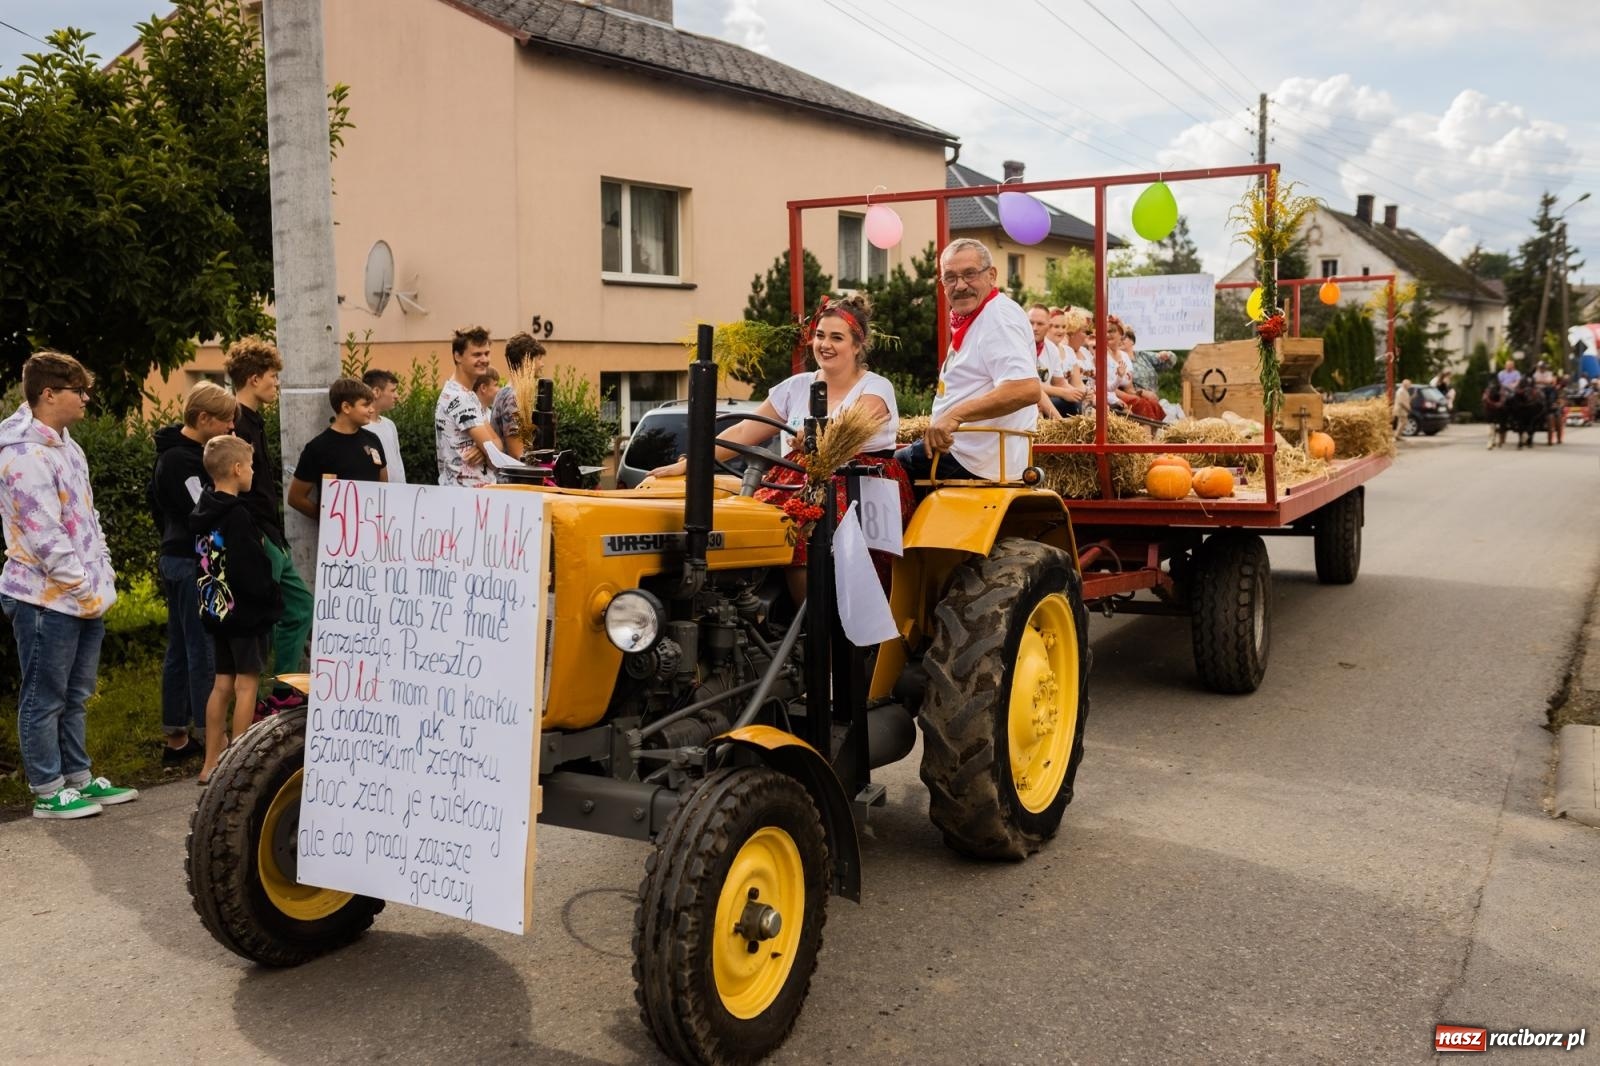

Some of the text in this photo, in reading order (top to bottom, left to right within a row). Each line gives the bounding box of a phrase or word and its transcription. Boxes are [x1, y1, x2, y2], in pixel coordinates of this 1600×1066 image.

[532, 315, 553, 338] 59
[466, 494, 533, 573] Mulik
[321, 559, 377, 592] różnie
[385, 566, 409, 595] na
[416, 565, 457, 600] mnie
[316, 589, 510, 642] ale cały czas ze mnie
[400, 627, 482, 679] Przeszło
[315, 658, 351, 702] 50
[437, 686, 456, 718] na
[463, 682, 519, 726] karku
[312, 707, 325, 732] a
[415, 710, 445, 756] jak
[459, 725, 477, 749] w
[426, 749, 500, 790] zegarku
[299, 819, 326, 857] ale
[332, 817, 354, 857] do
[365, 830, 408, 875] pracy
[402, 790, 422, 829] je
[430, 787, 504, 858] wiekowy
[410, 868, 474, 921] gotowy
